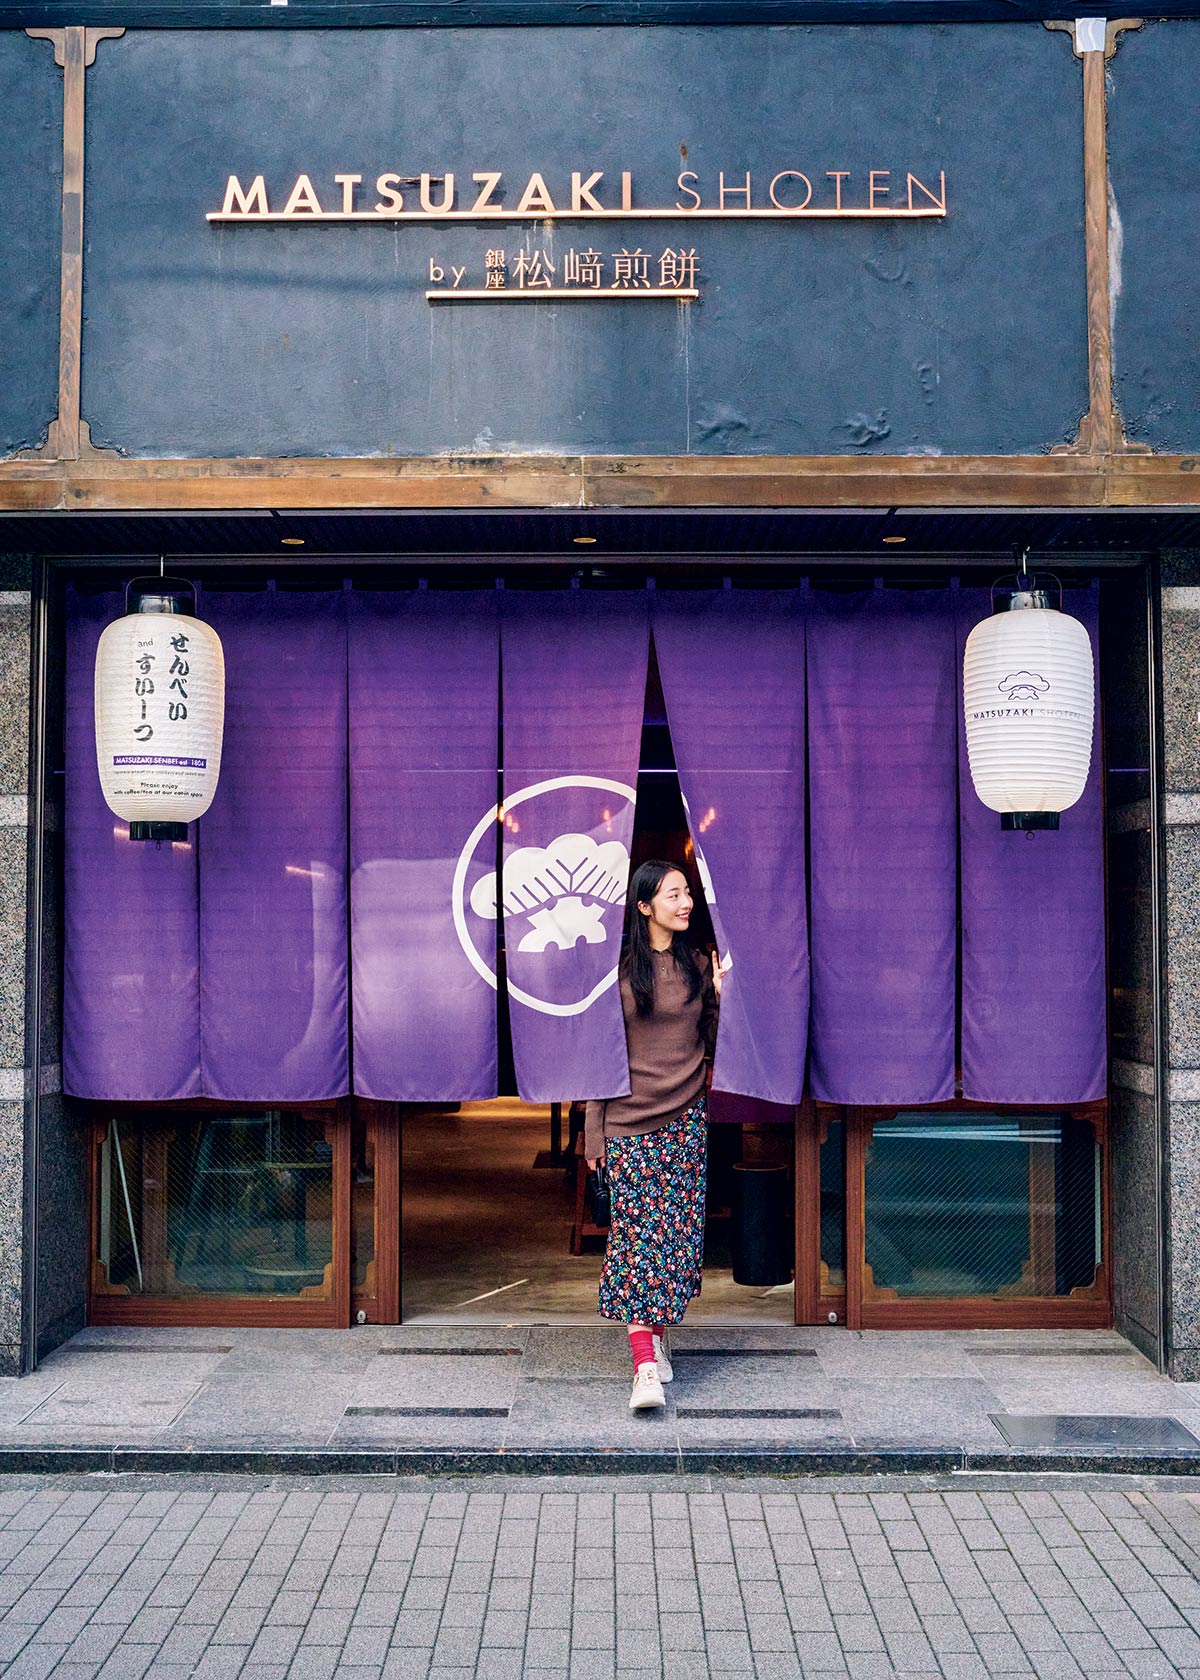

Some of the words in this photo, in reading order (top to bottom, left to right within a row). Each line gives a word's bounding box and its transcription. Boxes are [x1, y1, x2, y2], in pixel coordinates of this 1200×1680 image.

[222, 171, 631, 215] MATSUZAKI
[675, 170, 945, 211] SHOTEN
[429, 257, 466, 288] by
[484, 248, 506, 289] 銀座
[137, 638, 154, 647] and
[168, 632, 190, 721] せんべい
[133, 653, 155, 742] すいーつ
[973, 708, 1034, 720] MATSUZAKI
[1039, 709, 1081, 720] SHOTEN
[115, 756, 153, 764] MATSUZAKI
[154, 757, 178, 765] SENBEI
